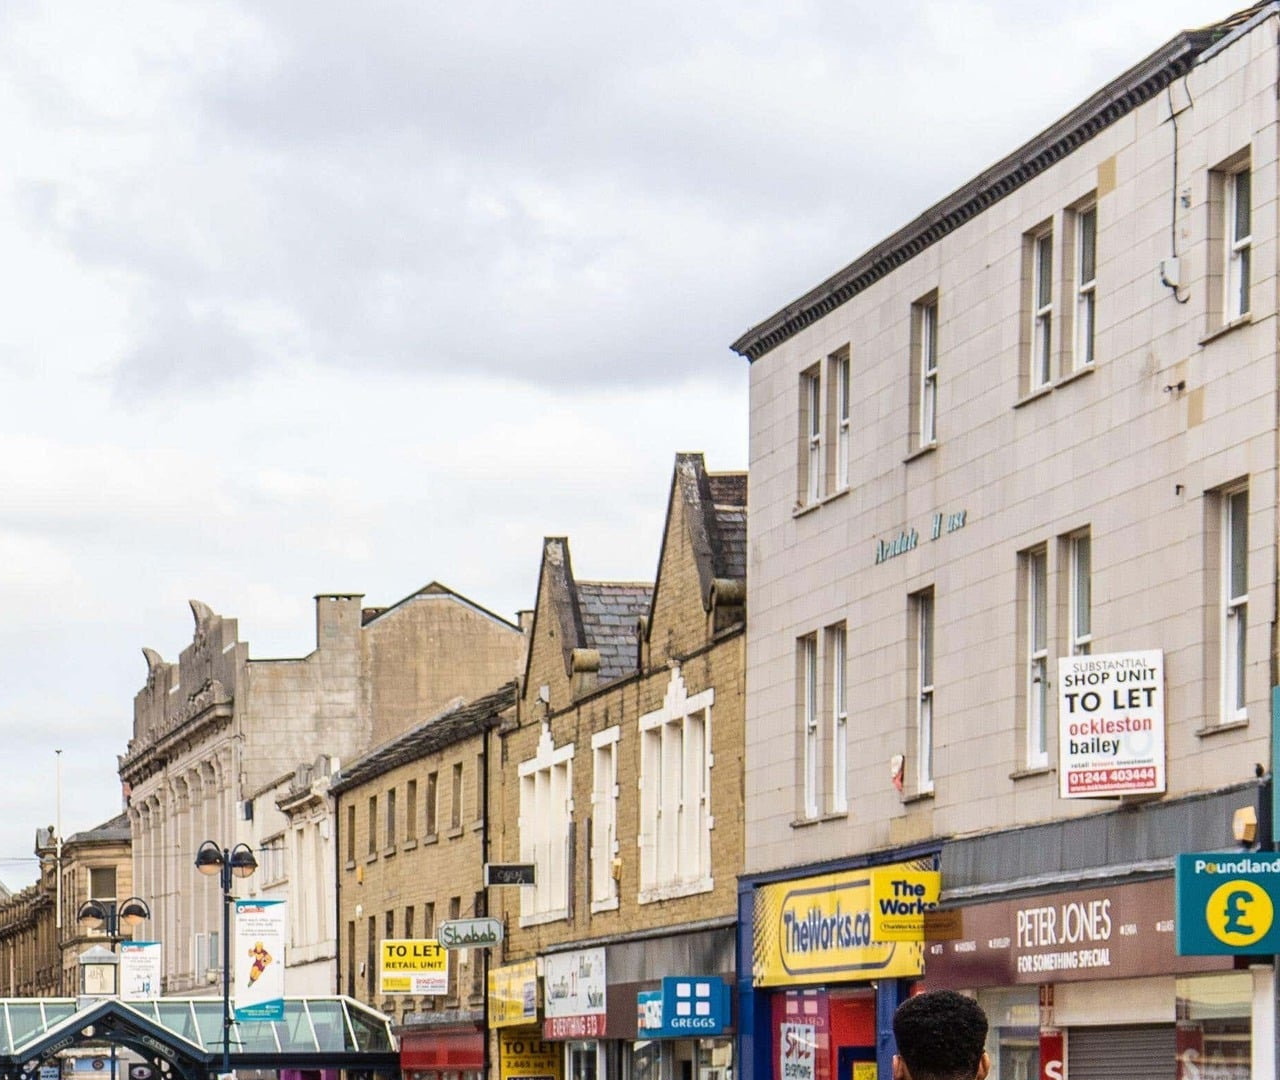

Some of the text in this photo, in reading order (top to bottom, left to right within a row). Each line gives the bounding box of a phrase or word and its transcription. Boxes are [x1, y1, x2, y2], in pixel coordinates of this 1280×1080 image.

[1073, 658, 1148, 673] SUBSTANTIAL
[1065, 668, 1157, 687] SHOP UNIT
[1065, 687, 1157, 713] TO LET
[1069, 717, 1153, 736] ockleston
[1070, 737, 1120, 756] bailey
[1070, 768, 1155, 785] 01244 403444
[1195, 858, 1280, 874] Poundland
[891, 880, 926, 897] The
[1016, 899, 1112, 948] PETER JONES
[386, 944, 442, 957] TO LET
[385, 961, 417, 969] RETAIL
[1017, 948, 1111, 973] FOR SOMETHING SPECIAL
[671, 1018, 715, 1028] GREGGS
[504, 1041, 556, 1054] TO LET
